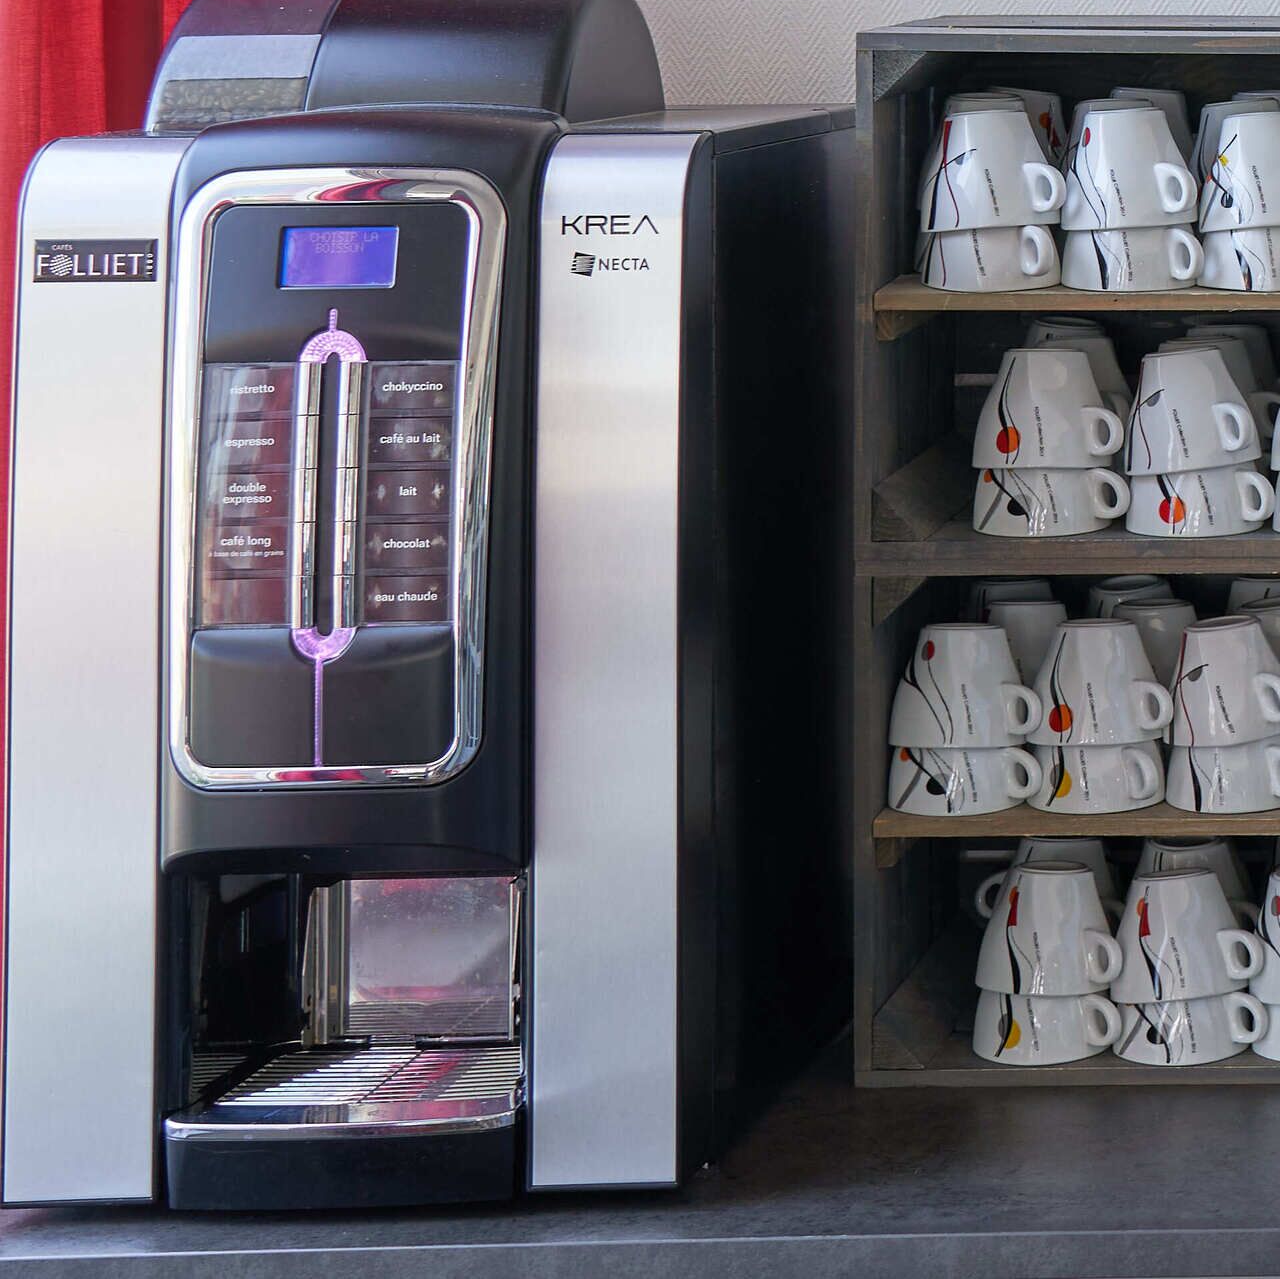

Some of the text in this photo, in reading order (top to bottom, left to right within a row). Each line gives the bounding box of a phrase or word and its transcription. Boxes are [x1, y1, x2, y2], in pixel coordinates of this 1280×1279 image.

[36, 253, 145, 276] FOLLIET
[598, 258, 650, 271] NECTA
[230, 384, 276, 395] ristretto
[382, 381, 443, 393] chokyccino
[224, 438, 275, 448] espresso
[380, 432, 441, 444] café au lait
[228, 482, 267, 493] double
[399, 486, 418, 496] lait
[222, 495, 273, 506] expresso
[220, 535, 272, 548] café long
[383, 538, 431, 549] chocolat
[374, 591, 438, 602] eau chaude
